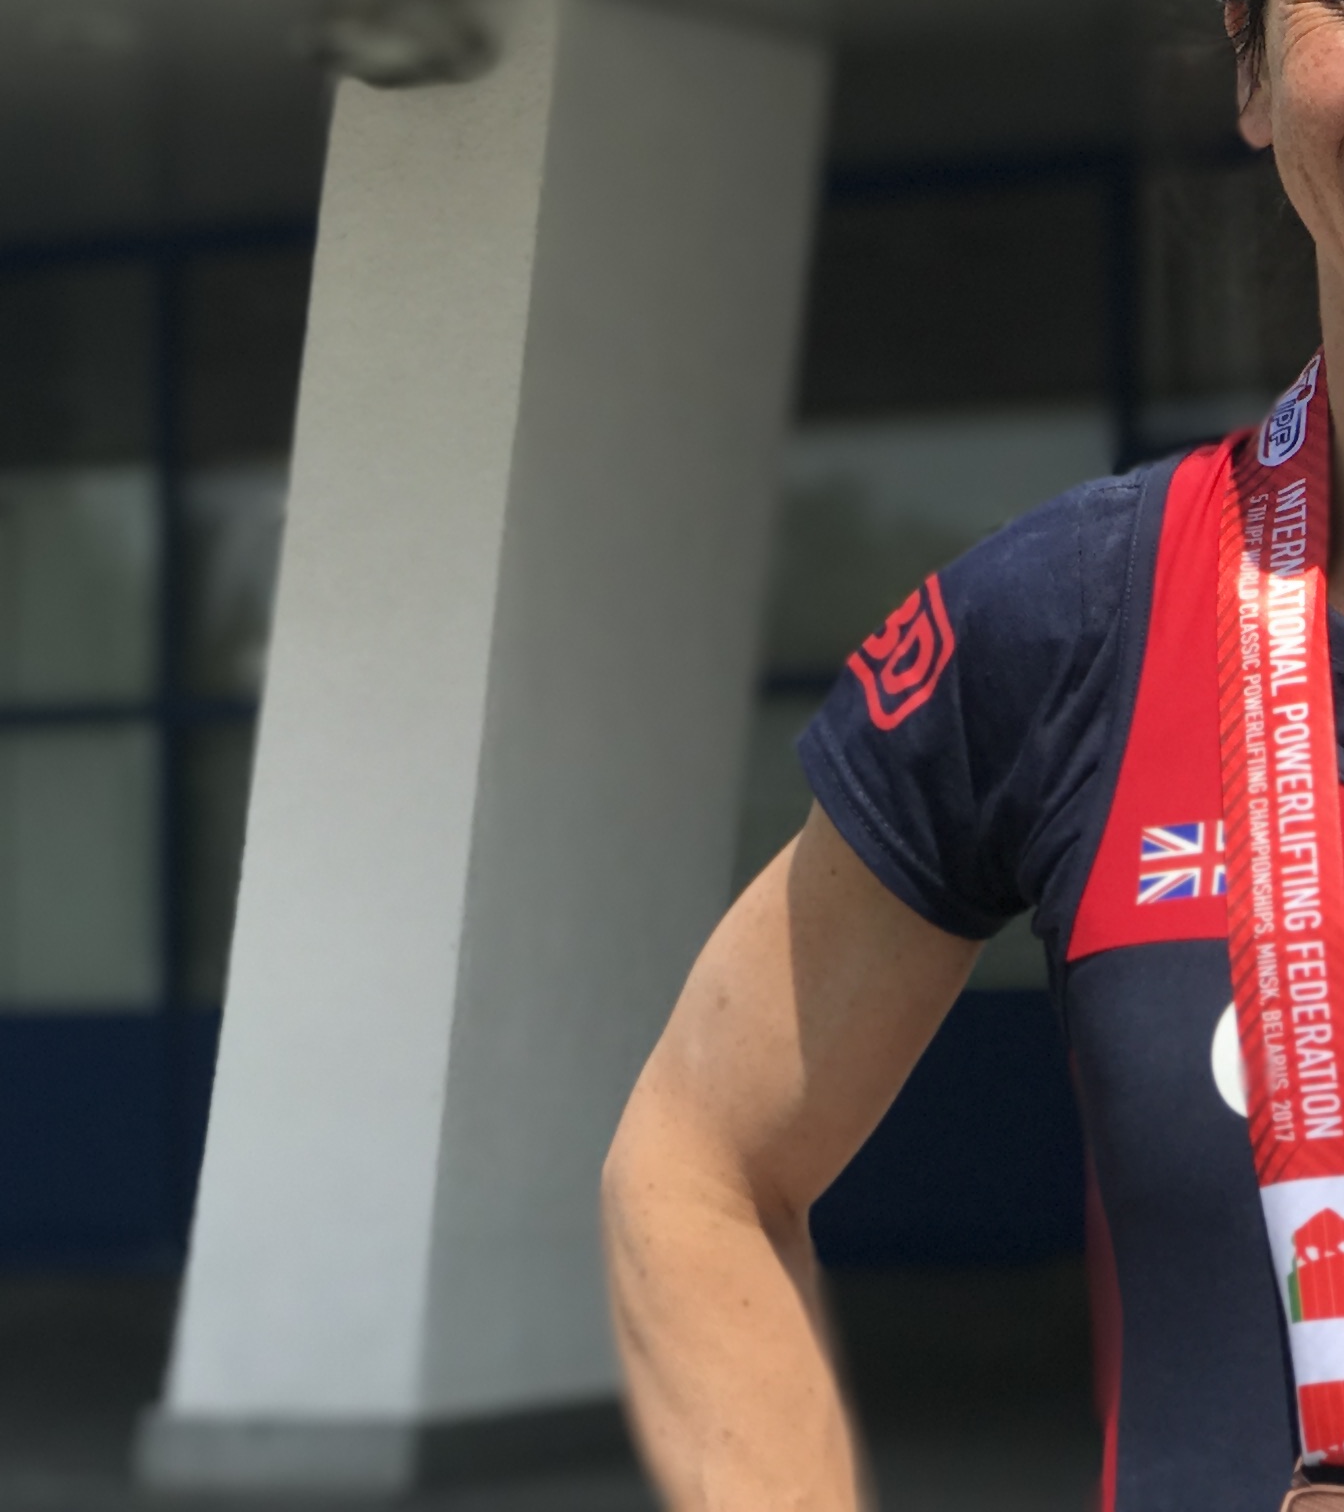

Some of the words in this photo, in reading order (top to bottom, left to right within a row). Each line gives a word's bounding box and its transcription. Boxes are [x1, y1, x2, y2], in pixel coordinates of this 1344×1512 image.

[1238, 548, 1261, 600] WORLD
[1267, 478, 1308, 697] INTERNATIONAL
[1239, 602, 1261, 671] CLASSIC
[1243, 674, 1268, 794] POWERLIFTING
[1272, 702, 1322, 931] POWERLIFTING
[1286, 940, 1344, 1141] FEDERATION
[1271, 1099, 1296, 1142] 2017
